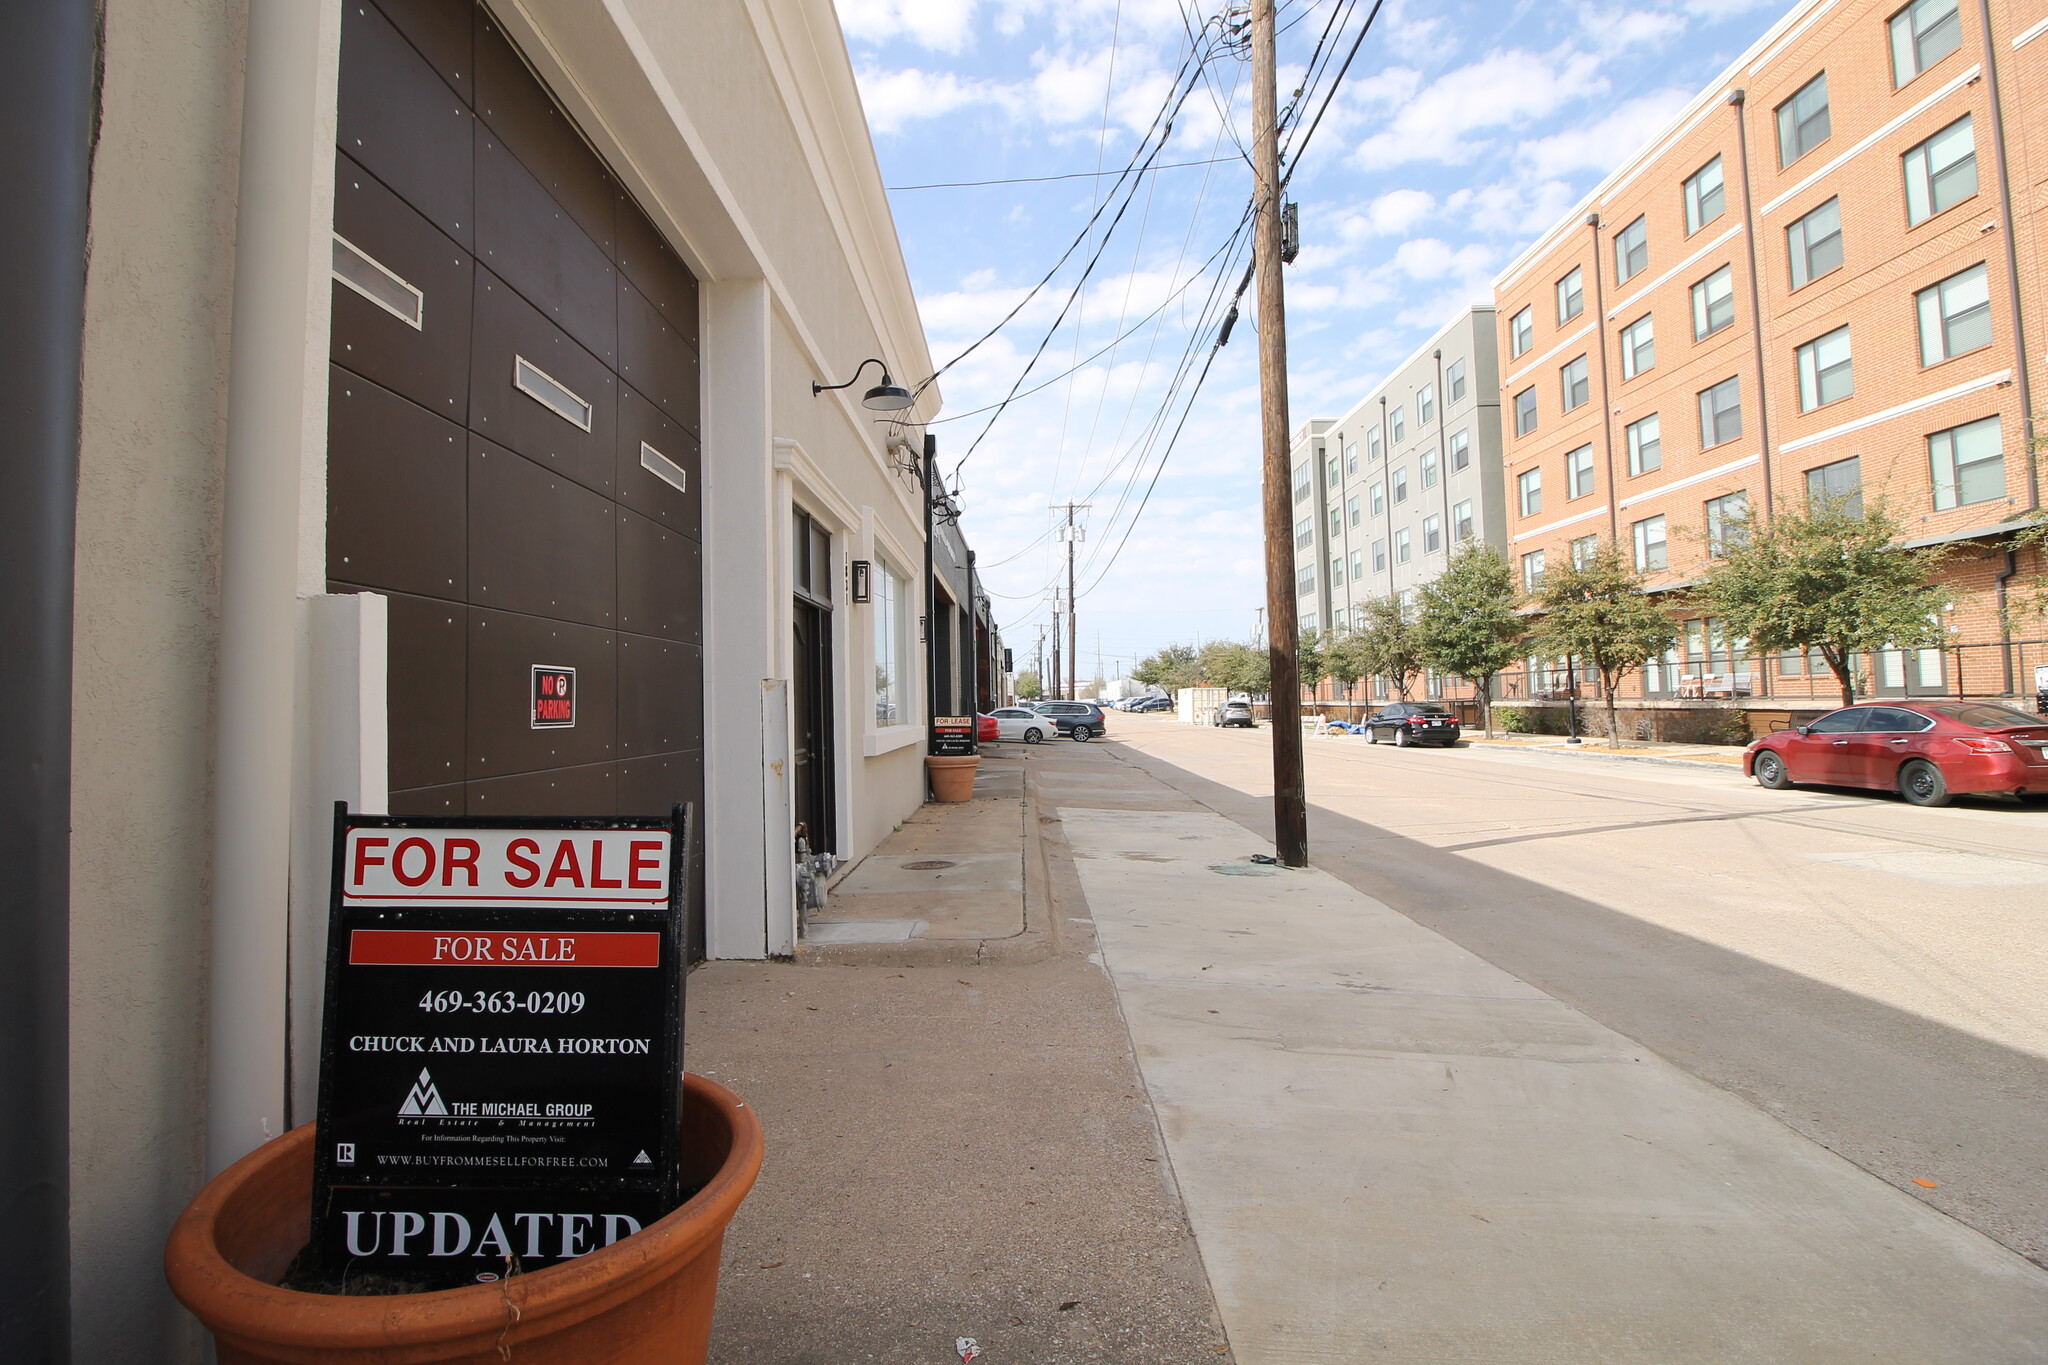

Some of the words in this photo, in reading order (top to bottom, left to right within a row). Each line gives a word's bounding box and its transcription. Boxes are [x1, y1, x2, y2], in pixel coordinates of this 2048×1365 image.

[542, 675, 554, 696] NO
[537, 699, 571, 720] PARKING
[353, 837, 481, 887] FOR
[504, 838, 663, 889] SALE
[433, 936, 494, 961] FOR
[501, 937, 576, 962] SALE
[419, 990, 586, 1014] 469-363-0209
[349, 1035, 426, 1053] CHUCK
[428, 1036, 476, 1053] AND
[479, 1037, 553, 1054] LAURA
[557, 1038, 651, 1055] HORTON
[451, 1102, 478, 1116] THE
[481, 1103, 542, 1117] MICHAEL
[545, 1103, 593, 1117] GROUP
[398, 1118, 426, 1126] Real
[439, 1118, 479, 1127] Estate
[518, 1119, 595, 1129] Management
[421, 1134, 433, 1142] For
[434, 1134, 471, 1142] Information
[472, 1134, 505, 1144] Regarding
[506, 1135, 520, 1143] This
[521, 1135, 548, 1145] Property
[342, 1211, 642, 1258] UPDATED
